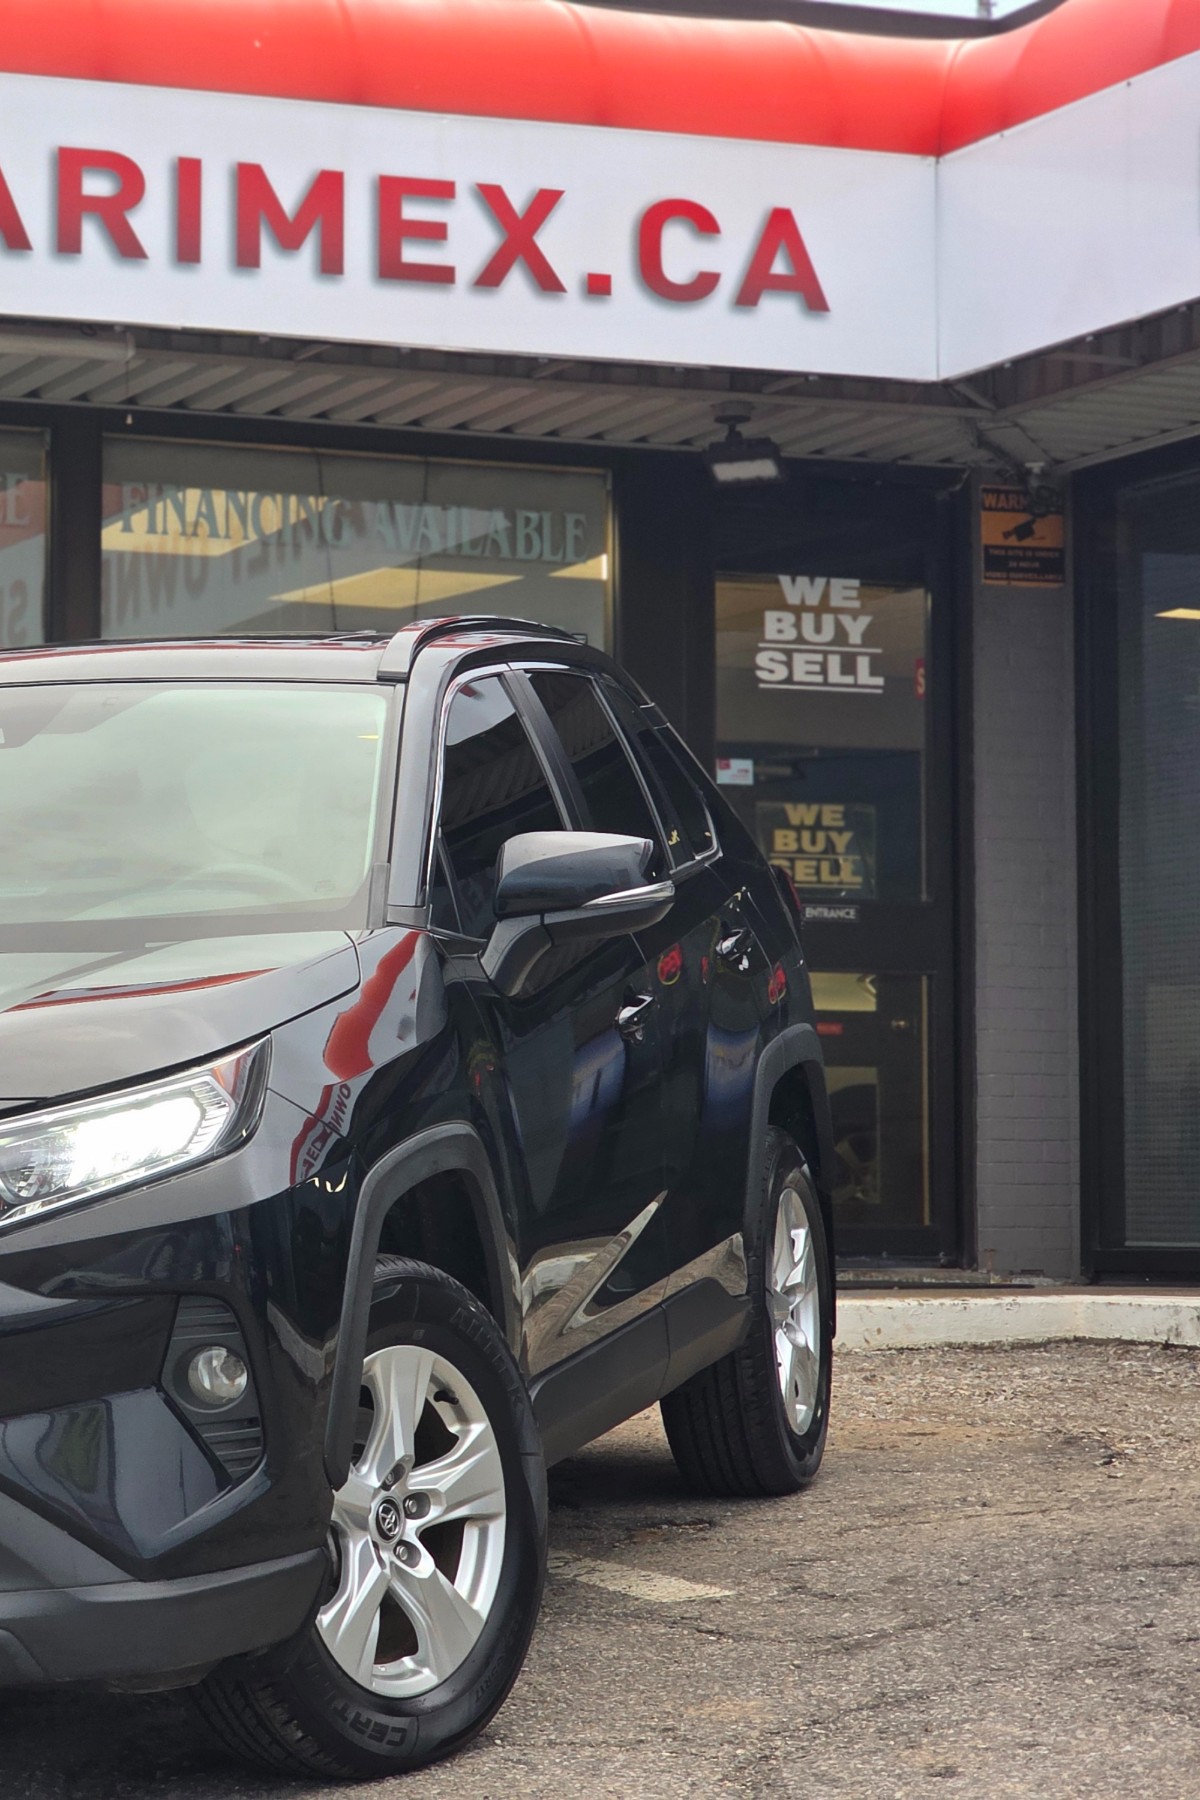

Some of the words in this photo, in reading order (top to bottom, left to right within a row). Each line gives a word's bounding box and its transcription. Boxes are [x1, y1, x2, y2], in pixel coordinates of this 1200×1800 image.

[121, 481, 353, 548] FINANCING
[373, 501, 589, 563] AVAILABLE
[777, 574, 862, 608] WE
[764, 610, 873, 645] BUY
[754, 650, 885, 686] SELL
[783, 803, 845, 827] WE
[772, 828, 853, 854] BUY
[804, 907, 857, 919] ENTRANCE
